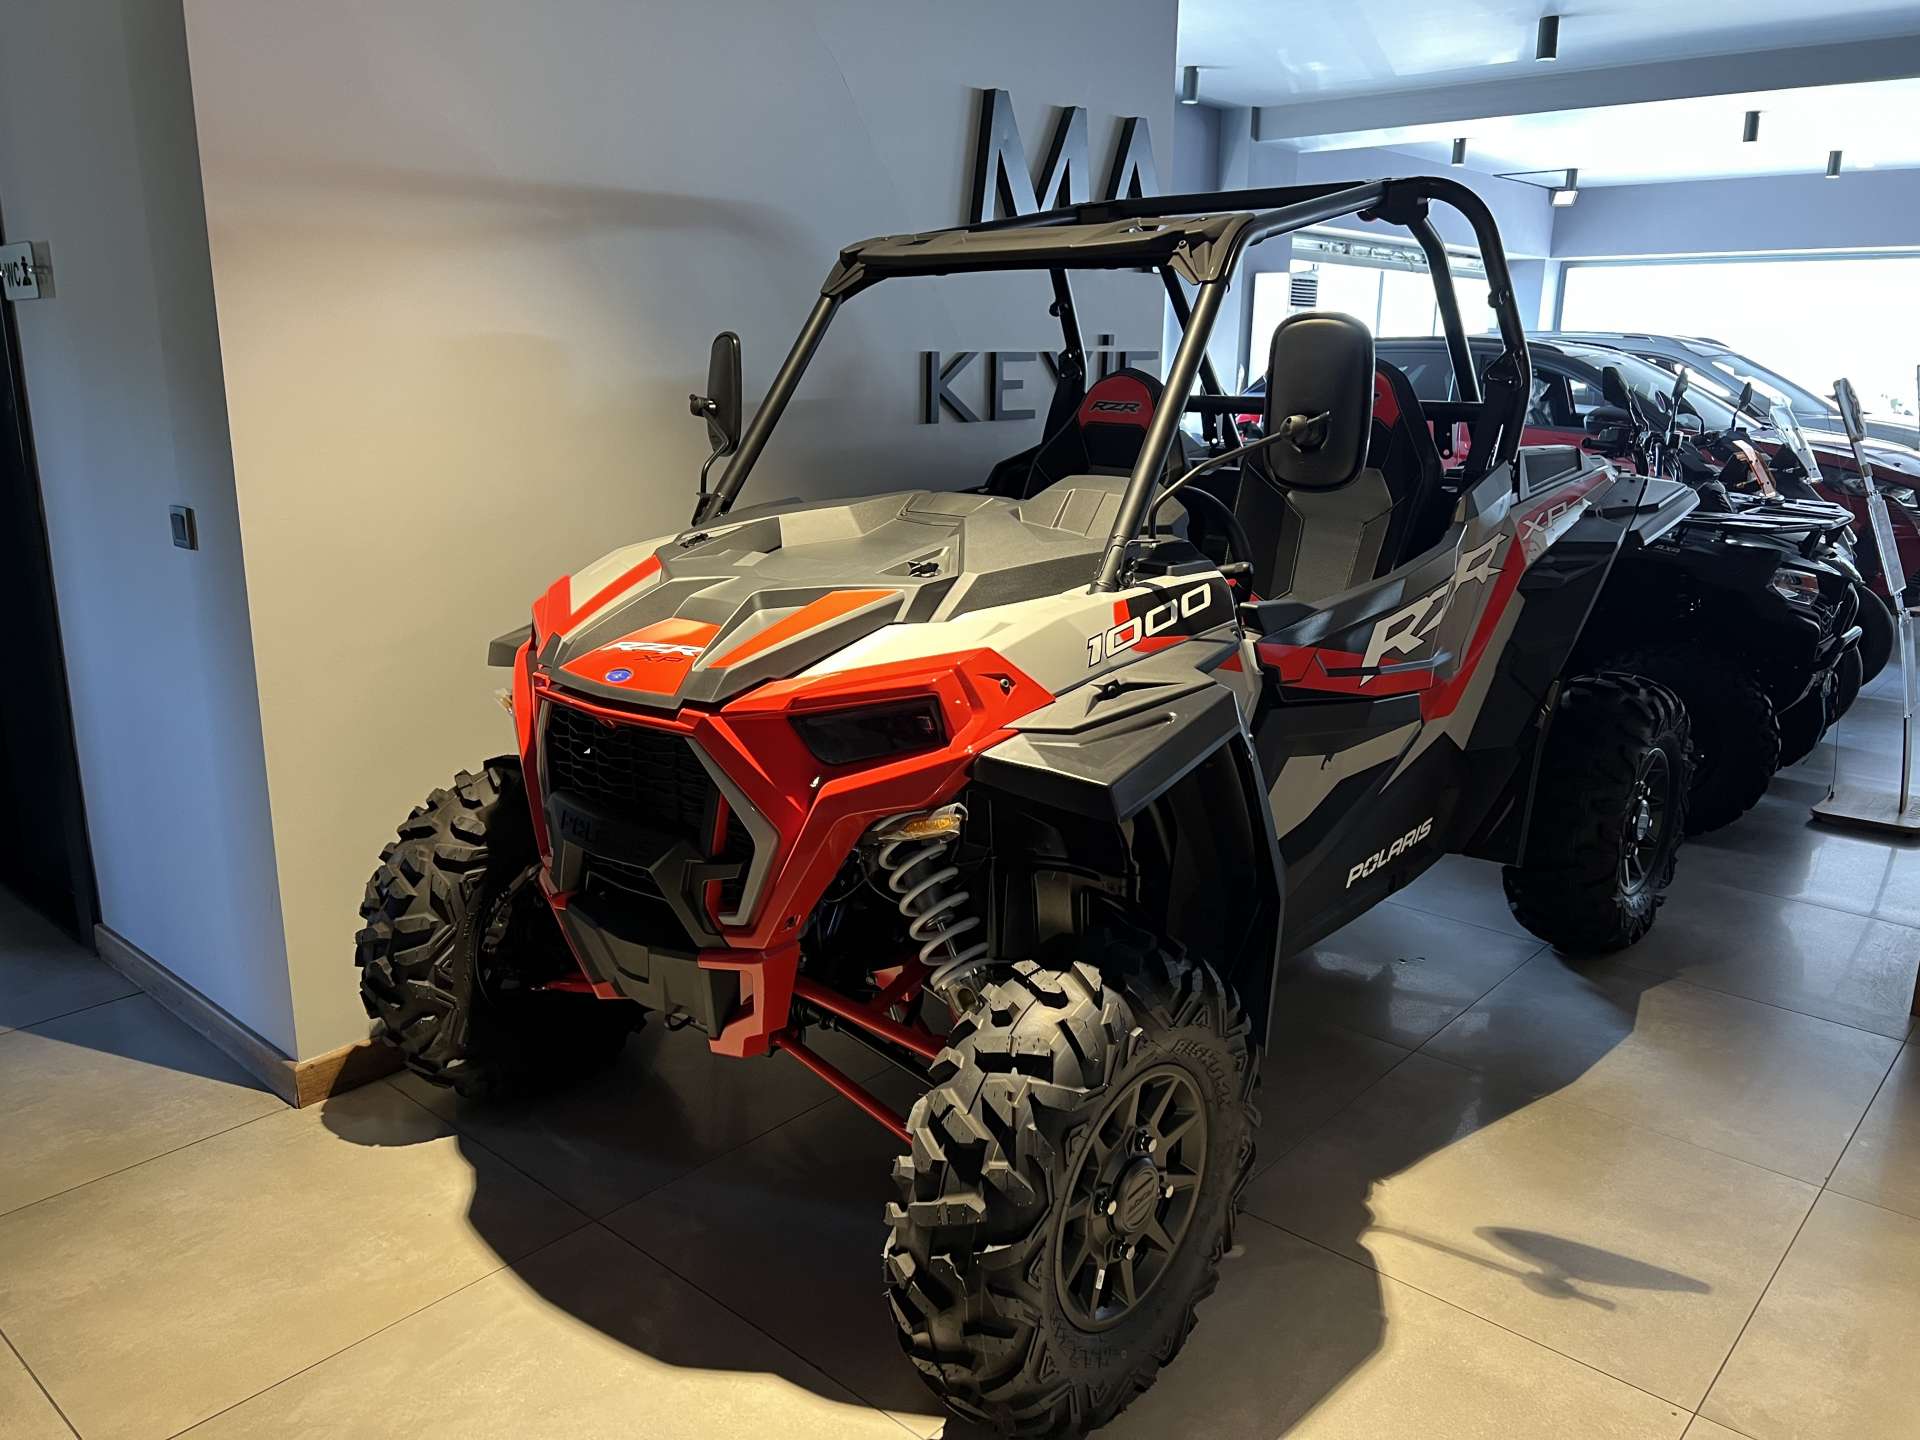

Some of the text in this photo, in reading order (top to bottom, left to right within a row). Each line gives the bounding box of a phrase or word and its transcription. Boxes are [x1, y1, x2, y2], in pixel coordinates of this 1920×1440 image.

[4, 261, 21, 289] WC
[1090, 400, 1143, 413] RZR
[1522, 501, 1568, 541] XP
[1087, 582, 1212, 668] 1000
[1359, 531, 1511, 687] RZR
[600, 641, 706, 657] RZR
[632, 655, 685, 664] XP
[1346, 817, 1433, 889] POLARIS
